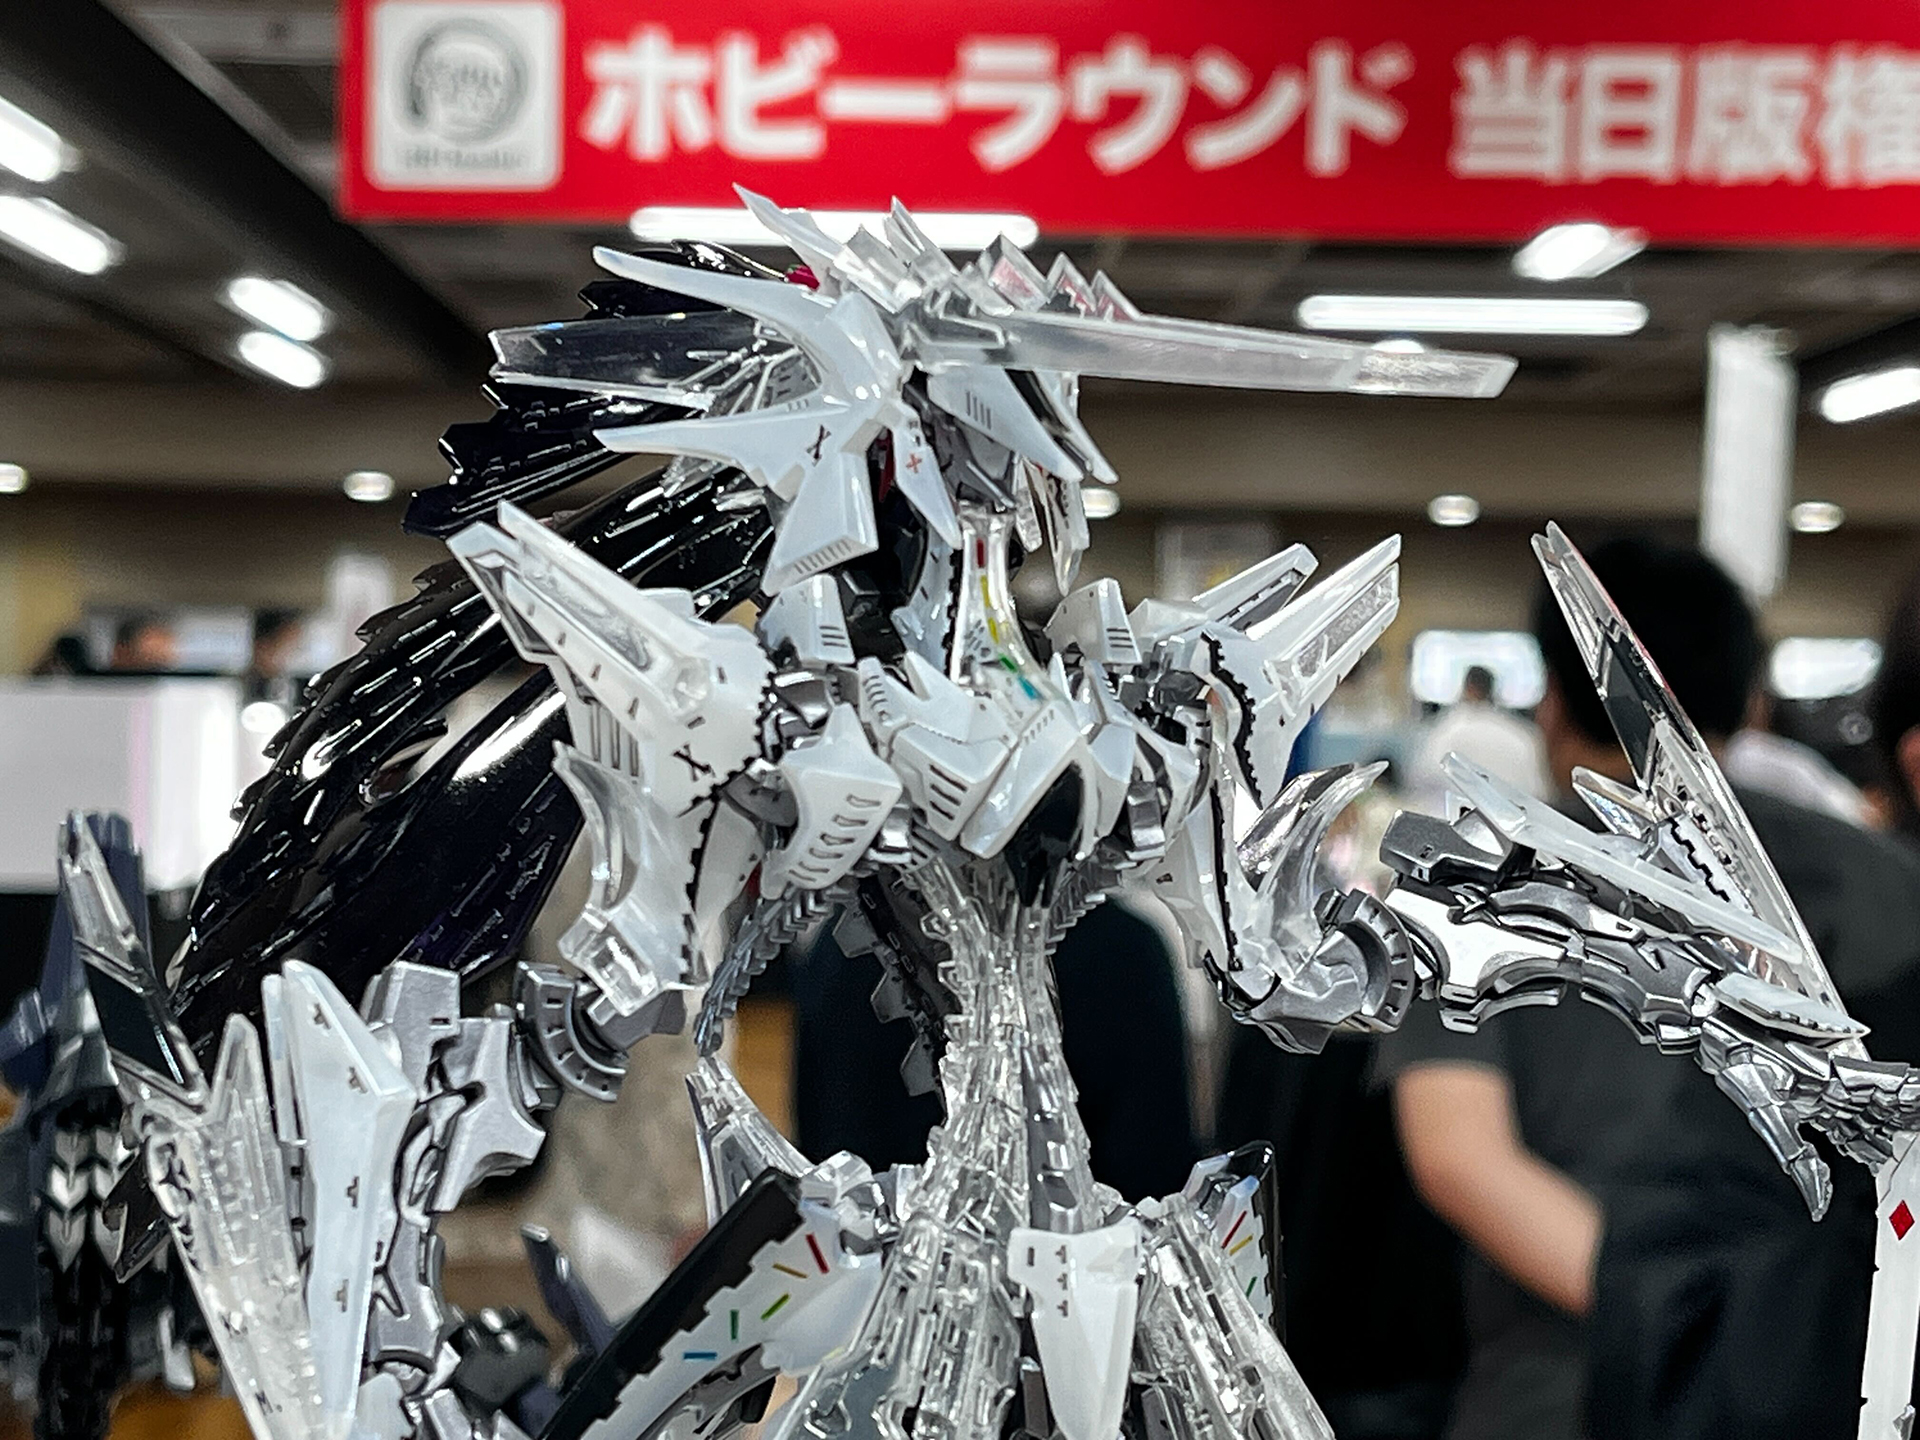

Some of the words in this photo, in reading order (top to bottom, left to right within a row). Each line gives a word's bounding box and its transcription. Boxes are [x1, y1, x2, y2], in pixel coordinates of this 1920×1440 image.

[583, 26, 1407, 174] ホビーラウンド
